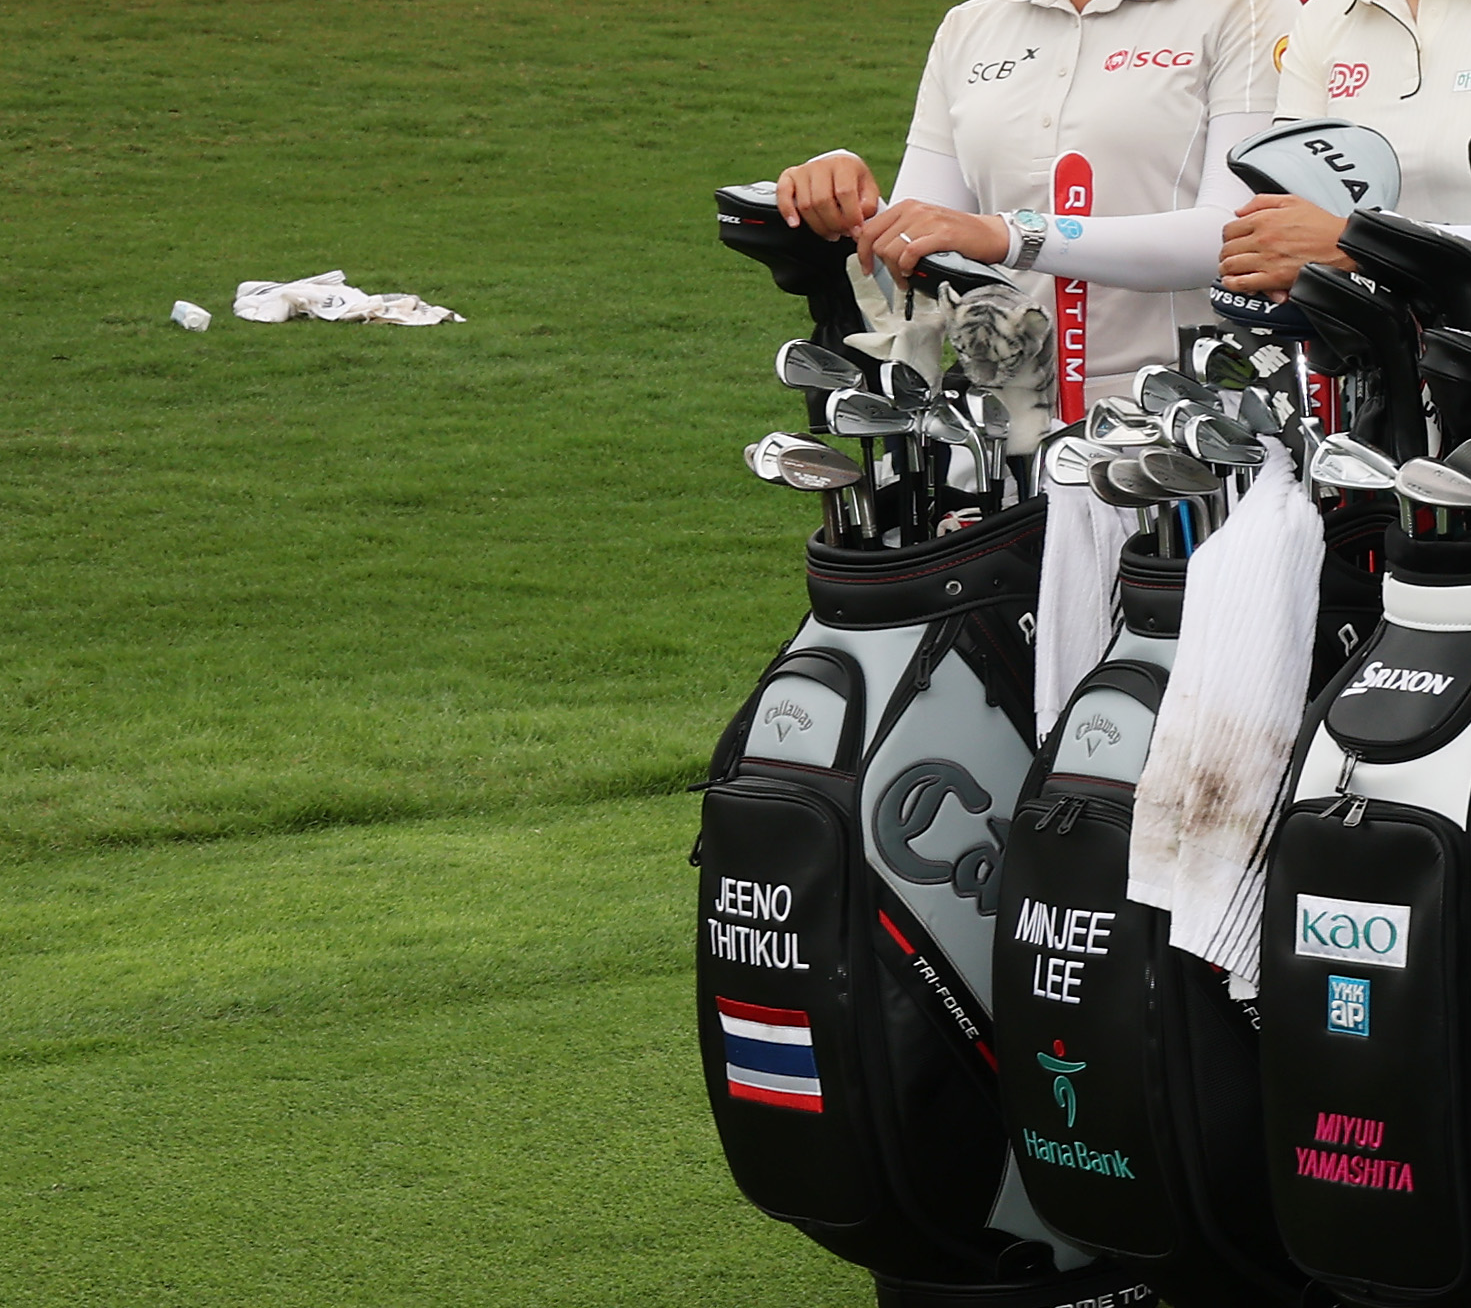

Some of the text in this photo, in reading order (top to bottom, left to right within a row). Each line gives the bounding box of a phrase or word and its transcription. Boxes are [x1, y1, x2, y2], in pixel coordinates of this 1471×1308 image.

[1133, 49, 1195, 68] SCG
[1209, 287, 1280, 315] YSSEY
[1341, 661, 1455, 697] SRIXON
[765, 700, 813, 731] Callaway
[1076, 714, 1122, 745] Callaway
[715, 876, 792, 922] JEENO
[708, 918, 810, 970] THITIKUL
[1015, 898, 1116, 955] MINJEE
[1302, 908, 1398, 954] kao
[912, 956, 980, 1040] TRI-FORCE
[1033, 955, 1083, 1004] LEE
[1331, 981, 1365, 1002] YKK
[1314, 1112, 1384, 1149] MIYUU
[1023, 1128, 1136, 1180] Hana Bank
[1295, 1147, 1415, 1192] YAMASHITA
